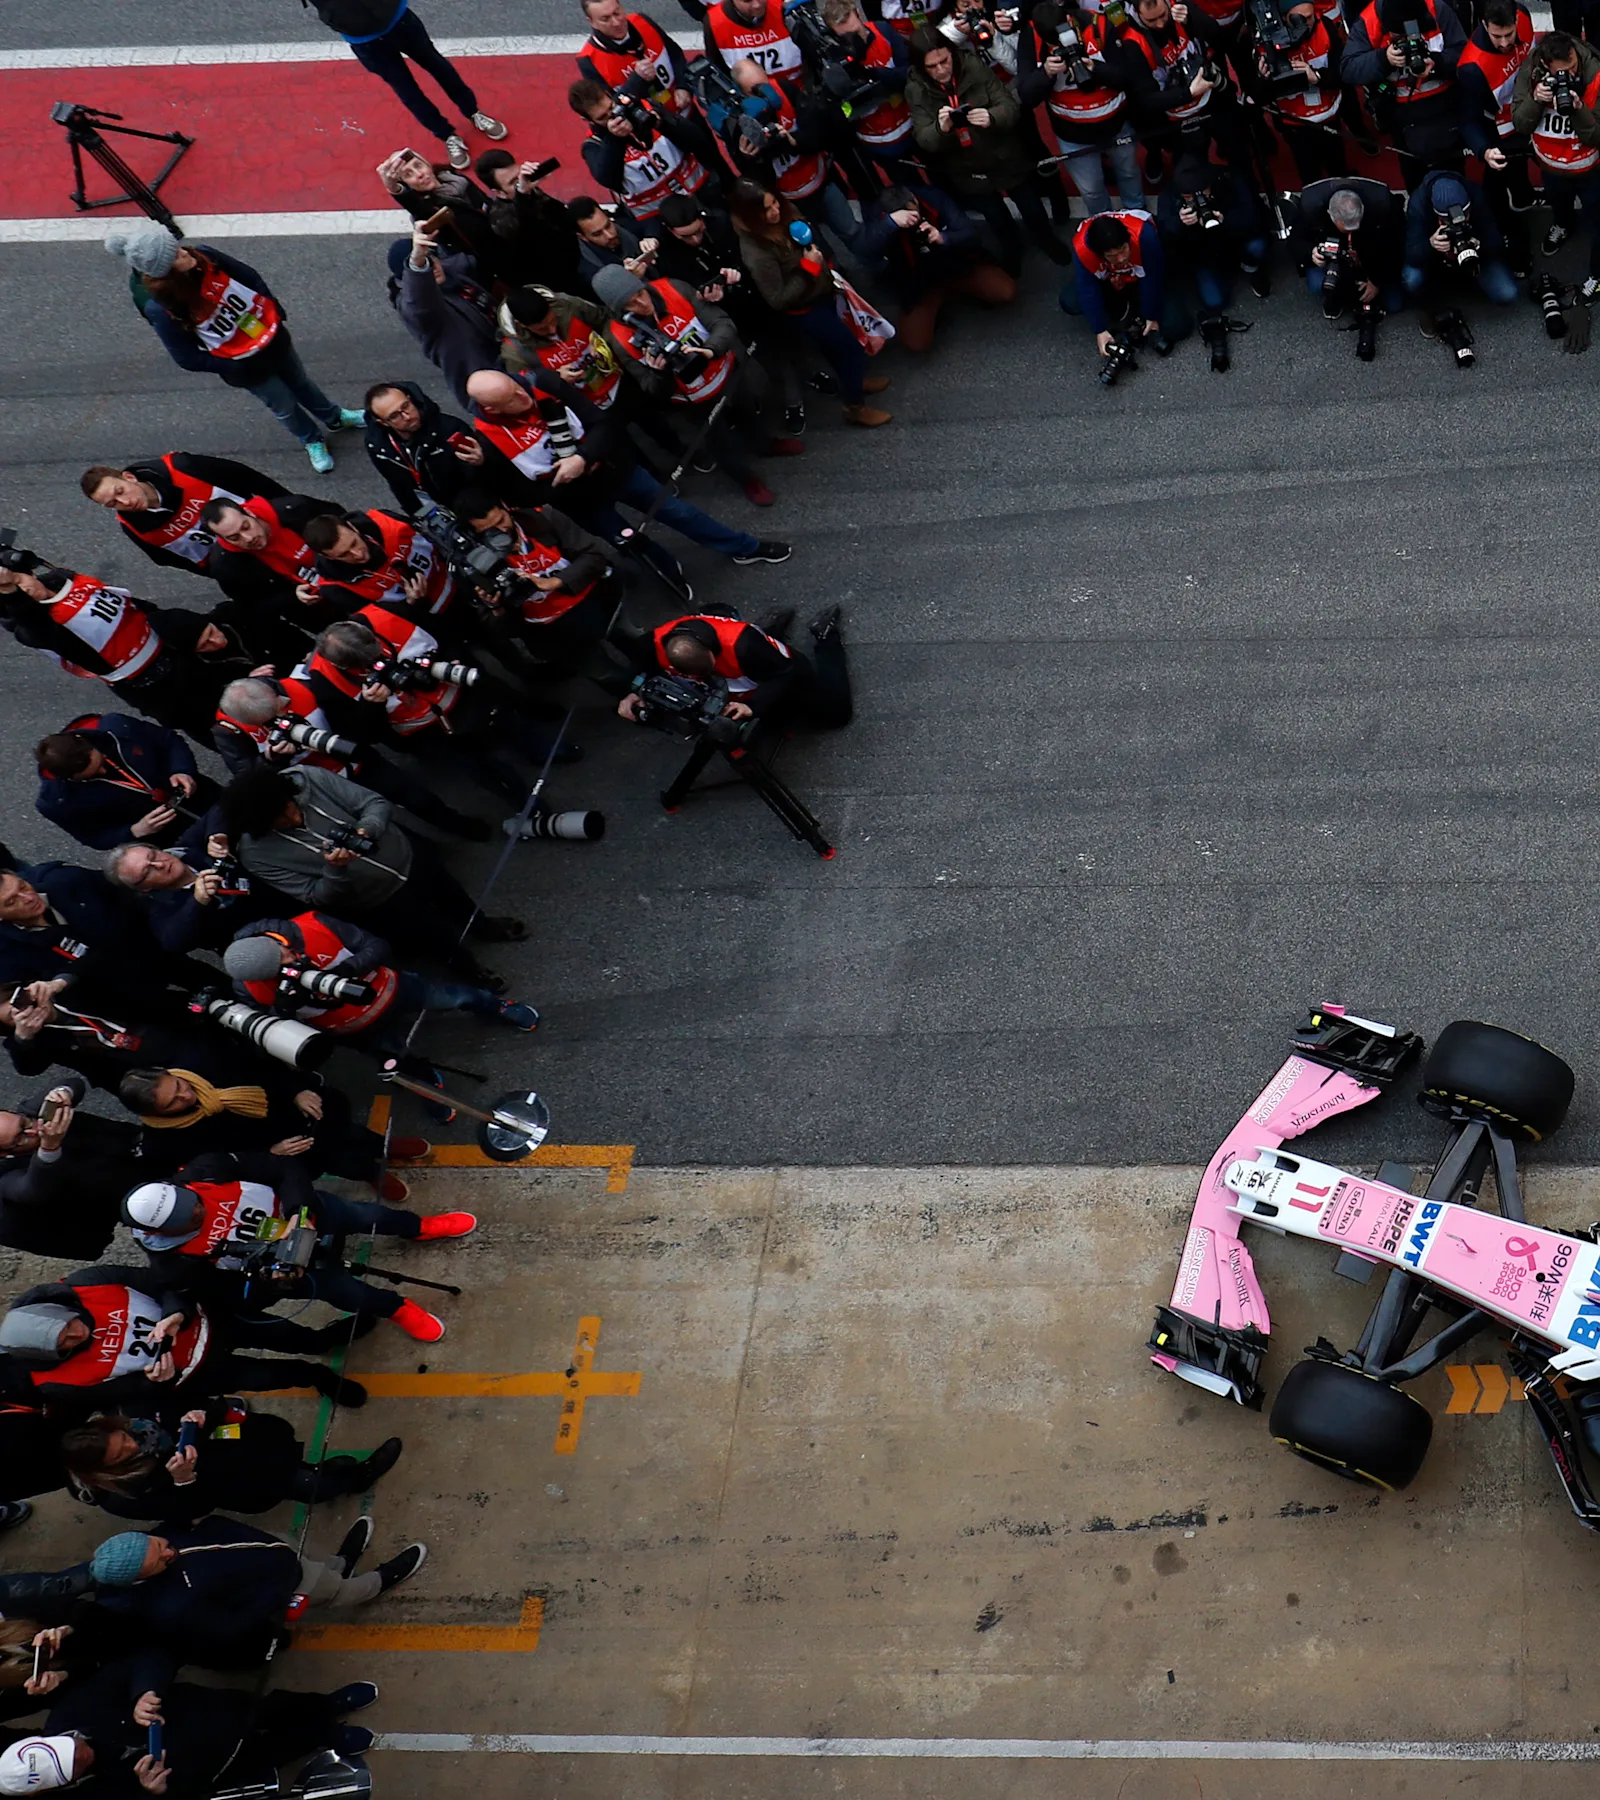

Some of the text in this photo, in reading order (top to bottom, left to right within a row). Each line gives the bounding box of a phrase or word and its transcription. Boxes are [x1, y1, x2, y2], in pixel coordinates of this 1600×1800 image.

[733, 29, 779, 47] MEDIA
[639, 152, 671, 183] 113
[207, 293, 248, 338] 1030
[163, 498, 205, 538] MEDIA
[90, 588, 123, 624] 103
[1254, 1061, 1307, 1126] MAGNESIUM
[1288, 1182, 1331, 1213] 11
[1320, 1181, 1348, 1230] PIRELLI
[1338, 1190, 1361, 1231] SOFINA
[204, 1200, 236, 1255] MEDIA
[1367, 1196, 1394, 1245] URALKALI
[1383, 1200, 1415, 1254] HYPE
[1403, 1202, 1443, 1267] BWT
[1181, 1228, 1210, 1307] MAGNESIUM
[1489, 1260, 1513, 1296] breast
[1500, 1263, 1518, 1298] cancer
[1507, 1266, 1527, 1301] care
[1529, 1243, 1572, 1322] 利来W66
[97, 1308, 125, 1363] MEDIA
